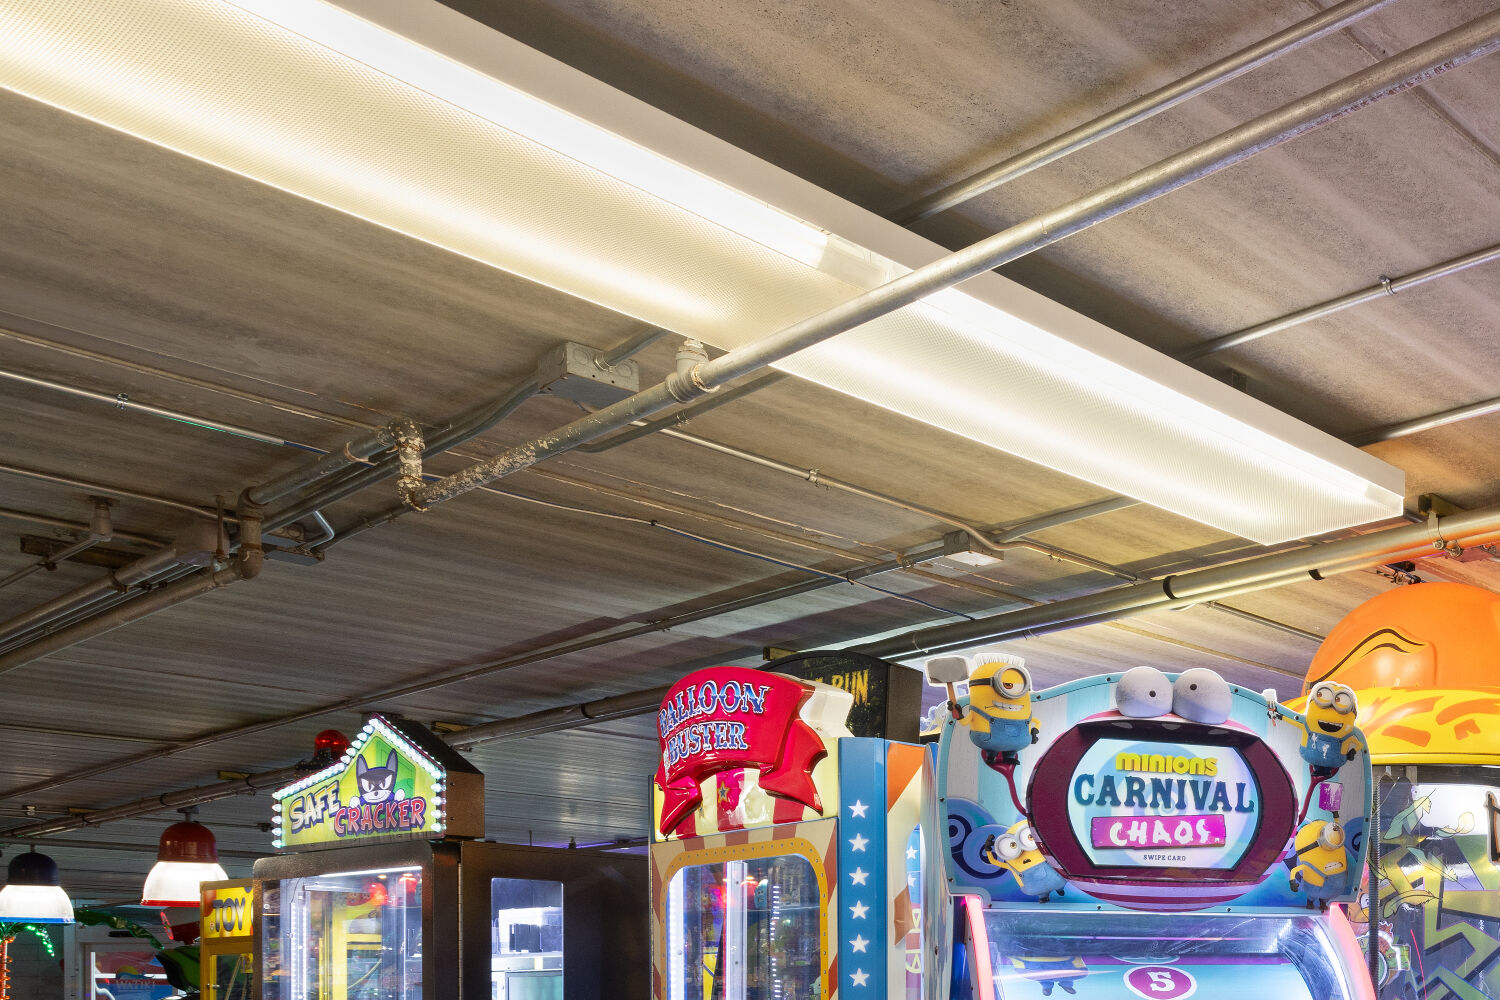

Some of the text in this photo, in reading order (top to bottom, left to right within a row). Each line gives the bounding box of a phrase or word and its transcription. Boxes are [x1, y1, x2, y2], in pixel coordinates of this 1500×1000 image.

[659, 680, 770, 738] BALLOON
[668, 721, 748, 765] BUSTER
[290, 780, 426, 836] SAFE CRACKER
[1074, 773, 1255, 813] CARNIVAL
[1109, 818, 1211, 846] CHAOS
[213, 897, 245, 932] TOY
[1149, 970, 1177, 993] 5
